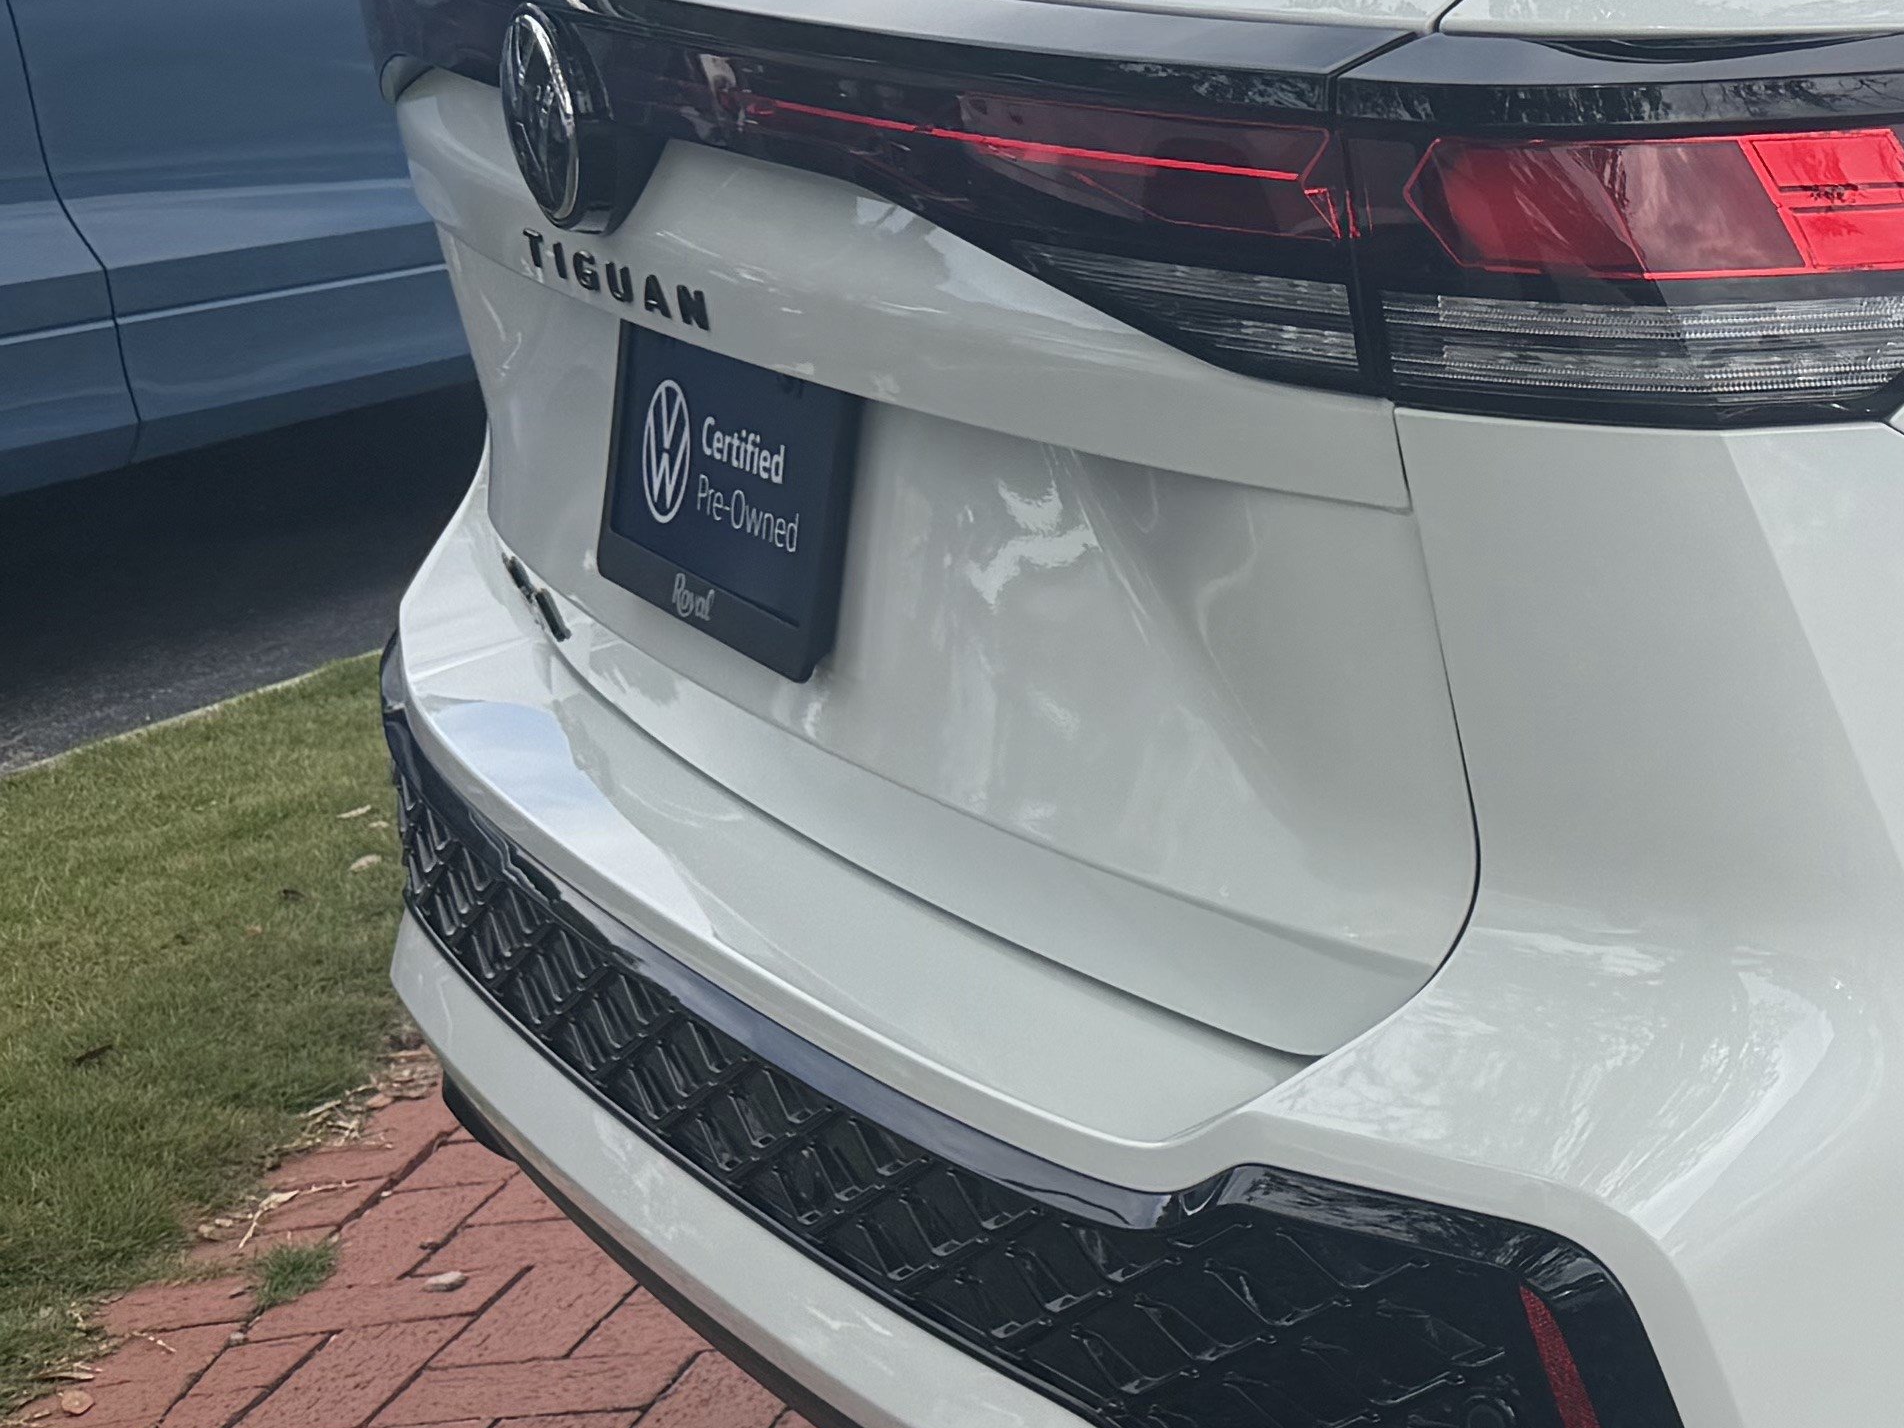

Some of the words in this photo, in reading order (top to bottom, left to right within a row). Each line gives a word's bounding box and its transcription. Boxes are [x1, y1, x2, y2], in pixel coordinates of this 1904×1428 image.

[522, 227, 711, 331] TIGUAN
[701, 416, 786, 485] Certified
[696, 474, 800, 553] Pre-Owned
[672, 572, 716, 621] Royal
